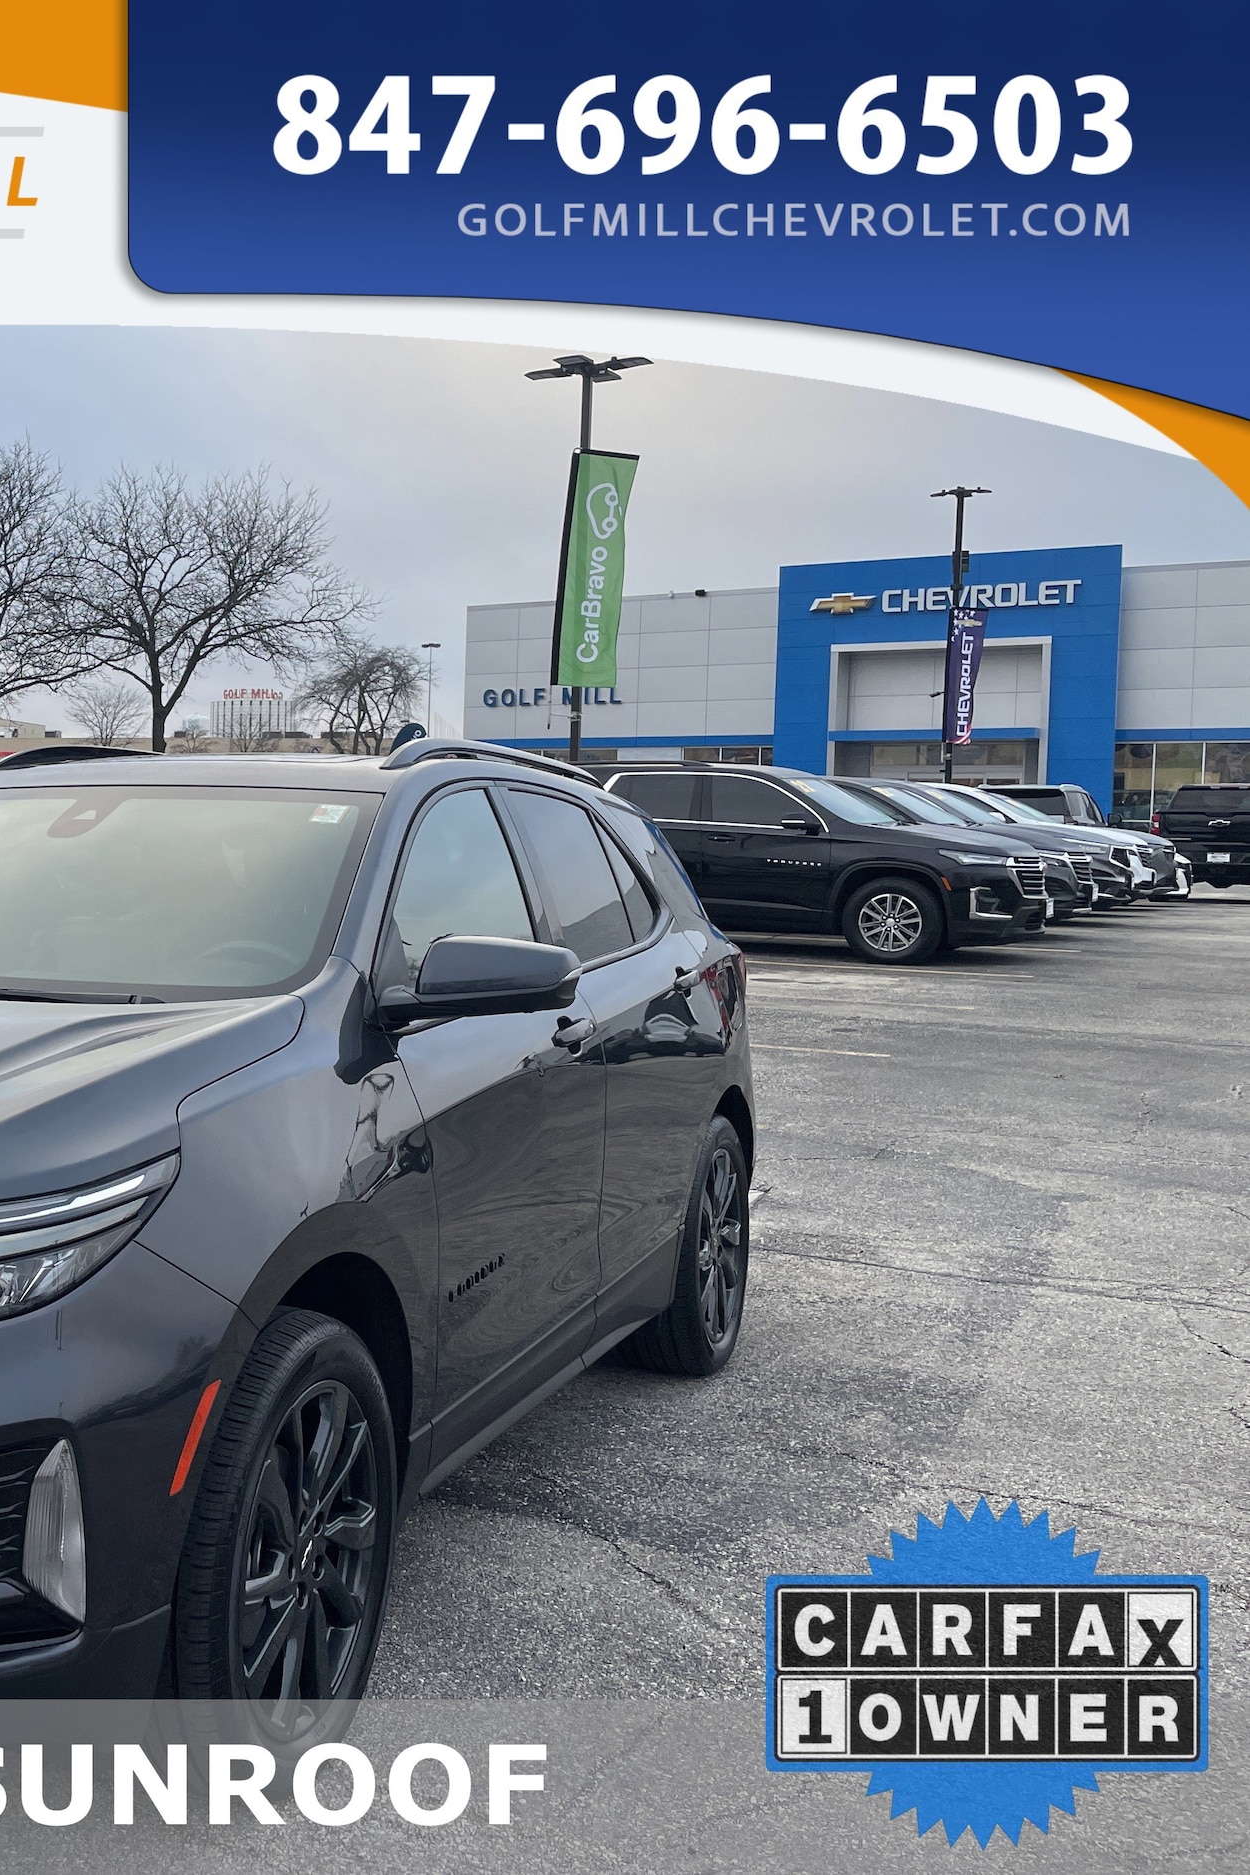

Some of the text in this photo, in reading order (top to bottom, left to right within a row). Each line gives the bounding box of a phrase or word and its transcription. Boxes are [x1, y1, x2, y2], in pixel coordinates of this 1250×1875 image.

[576, 546, 608, 663] CarBravo
[881, 579, 1082, 613] CHEVROLET
[223, 689, 247, 700] GOLF
[483, 688, 546, 707] GOLF
[956, 632, 974, 737] CHEVROLET
